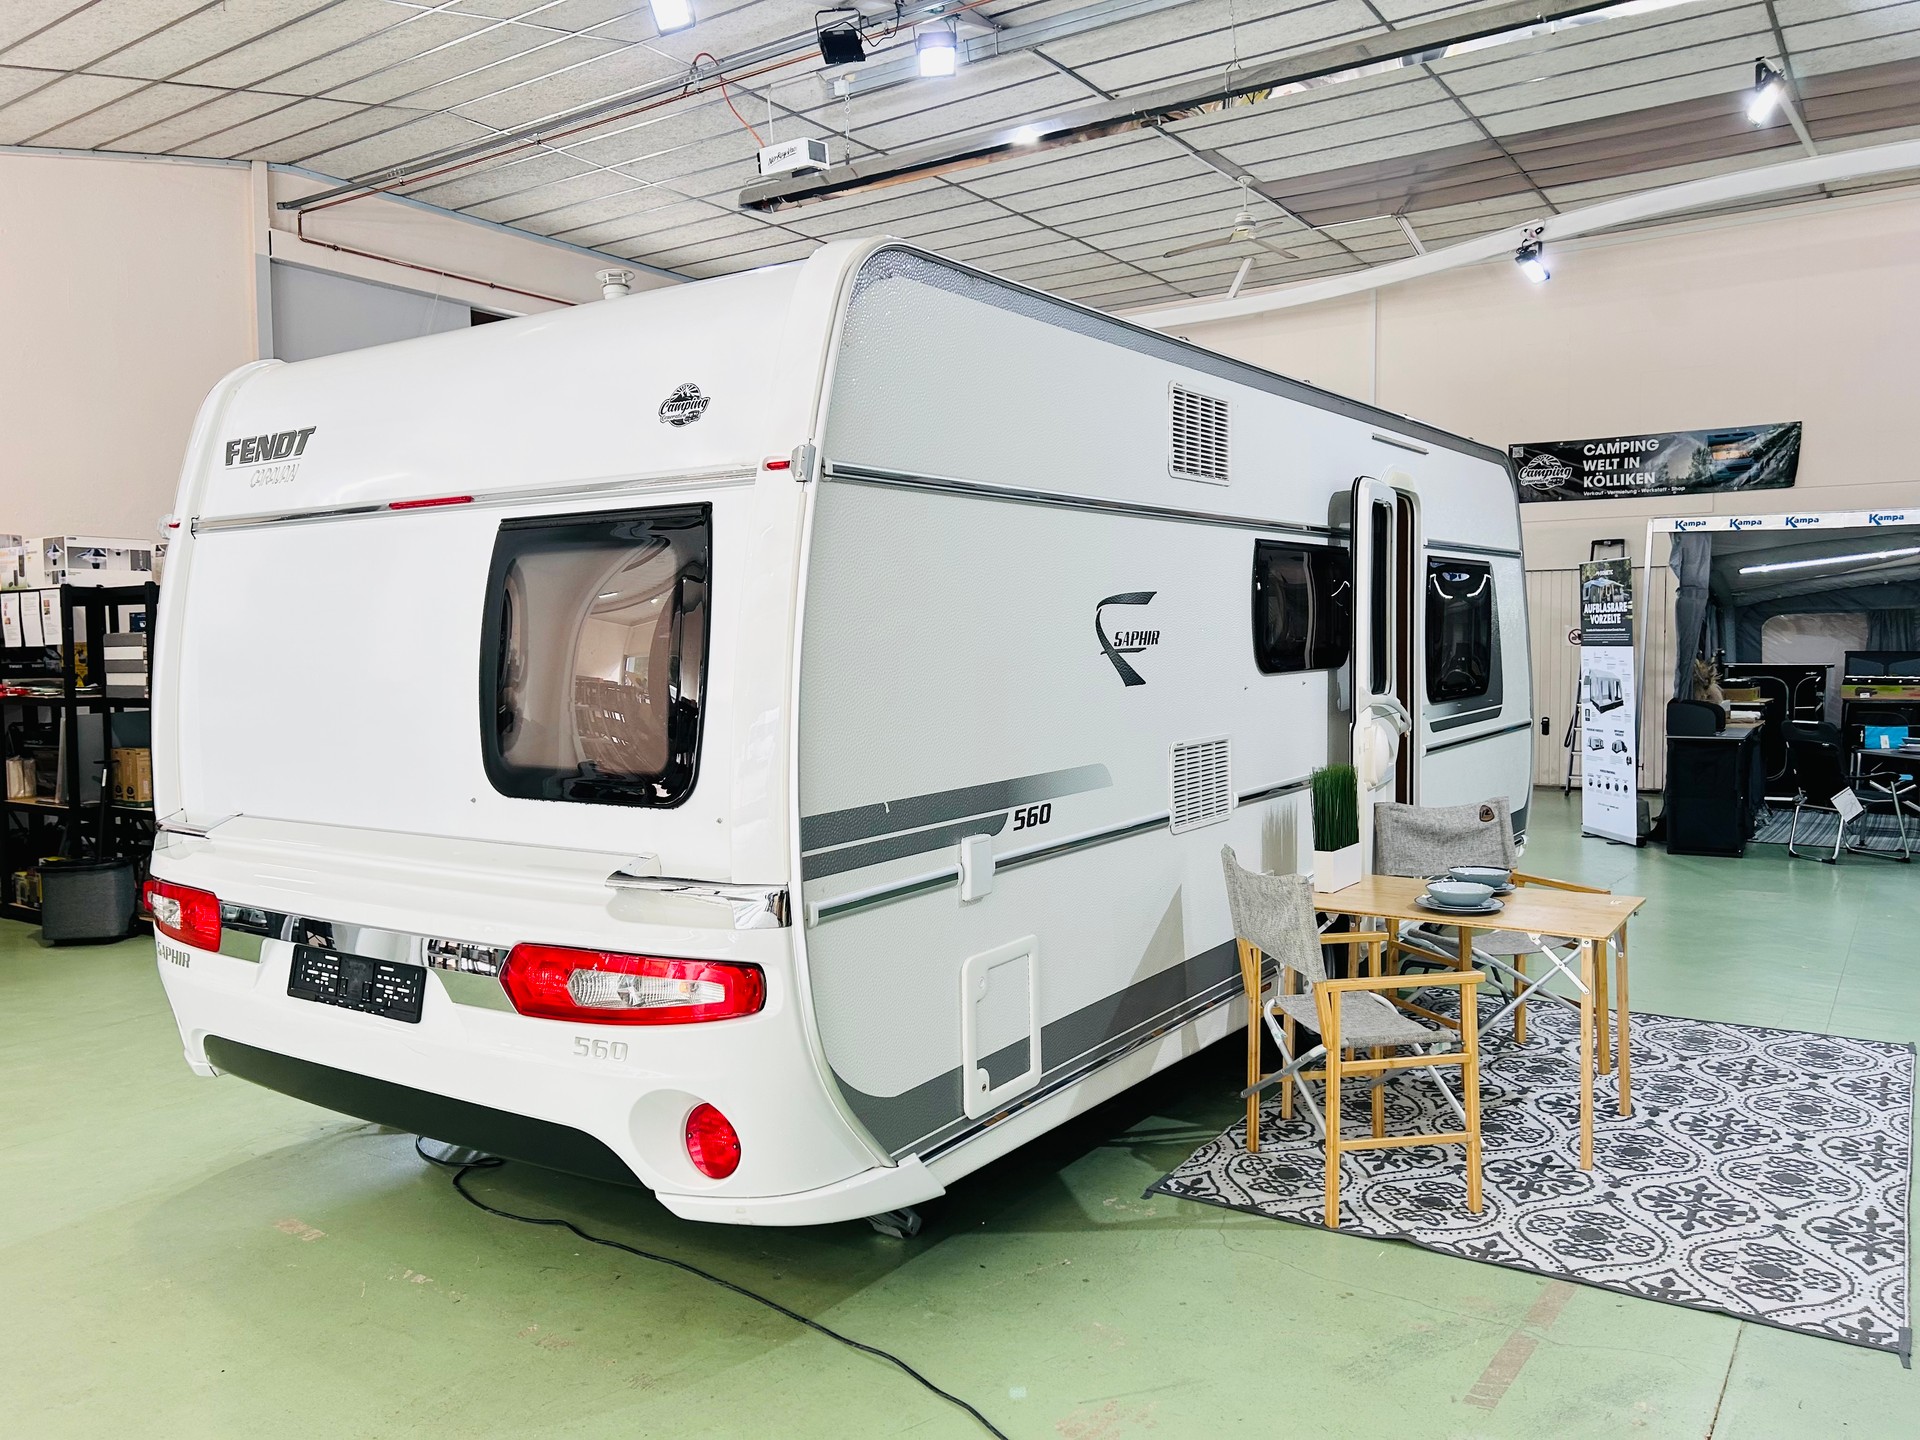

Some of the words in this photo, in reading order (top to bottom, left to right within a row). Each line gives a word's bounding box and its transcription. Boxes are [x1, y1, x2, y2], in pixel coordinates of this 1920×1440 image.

[660, 397, 710, 415] Camping
[225, 426, 317, 466] FENDT
[1583, 439, 1660, 456] CAMPING
[1582, 458, 1620, 472] WELT
[1623, 456, 1641, 470] IN
[250, 463, 300, 488] CARAVAN
[1518, 466, 1572, 480] Camping
[1583, 472, 1656, 488] KÖLLIKEN
[1675, 520, 1707, 531] Kampa
[1729, 518, 1762, 531] Kampa
[1785, 515, 1820, 528] Kampa
[1868, 513, 1905, 526] Kampa
[1583, 601, 1628, 614] AUFBLASBARE
[1589, 613, 1622, 625] VORZELTE
[1113, 630, 1160, 647] SAPHIR
[1012, 802, 1052, 832] 560
[157, 941, 191, 968] SAPHIR
[573, 1036, 629, 1062] 560
